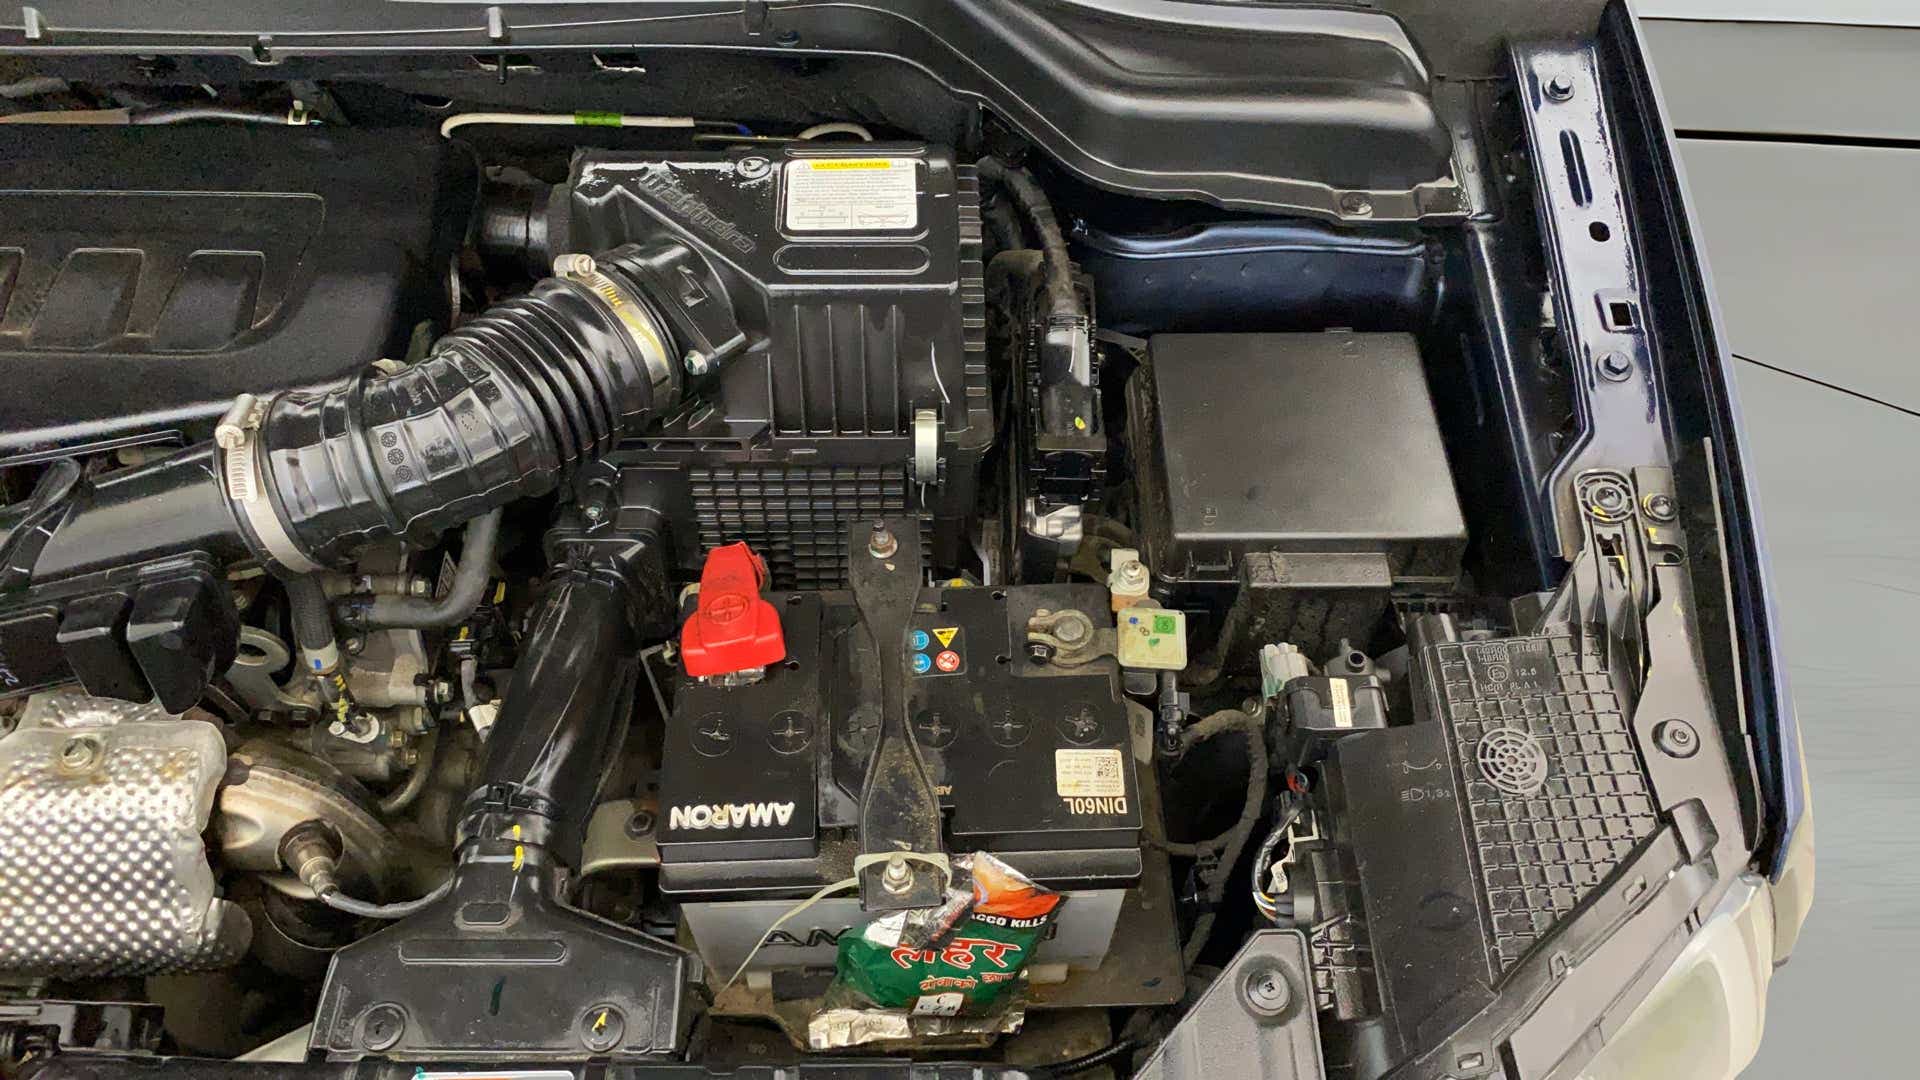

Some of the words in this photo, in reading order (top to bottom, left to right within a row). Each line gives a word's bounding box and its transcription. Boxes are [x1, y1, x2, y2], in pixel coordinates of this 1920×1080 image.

[1062, 797, 1128, 815] DIN60L
[669, 801, 795, 830] AMARON
[1010, 914, 1048, 928] KILLS
